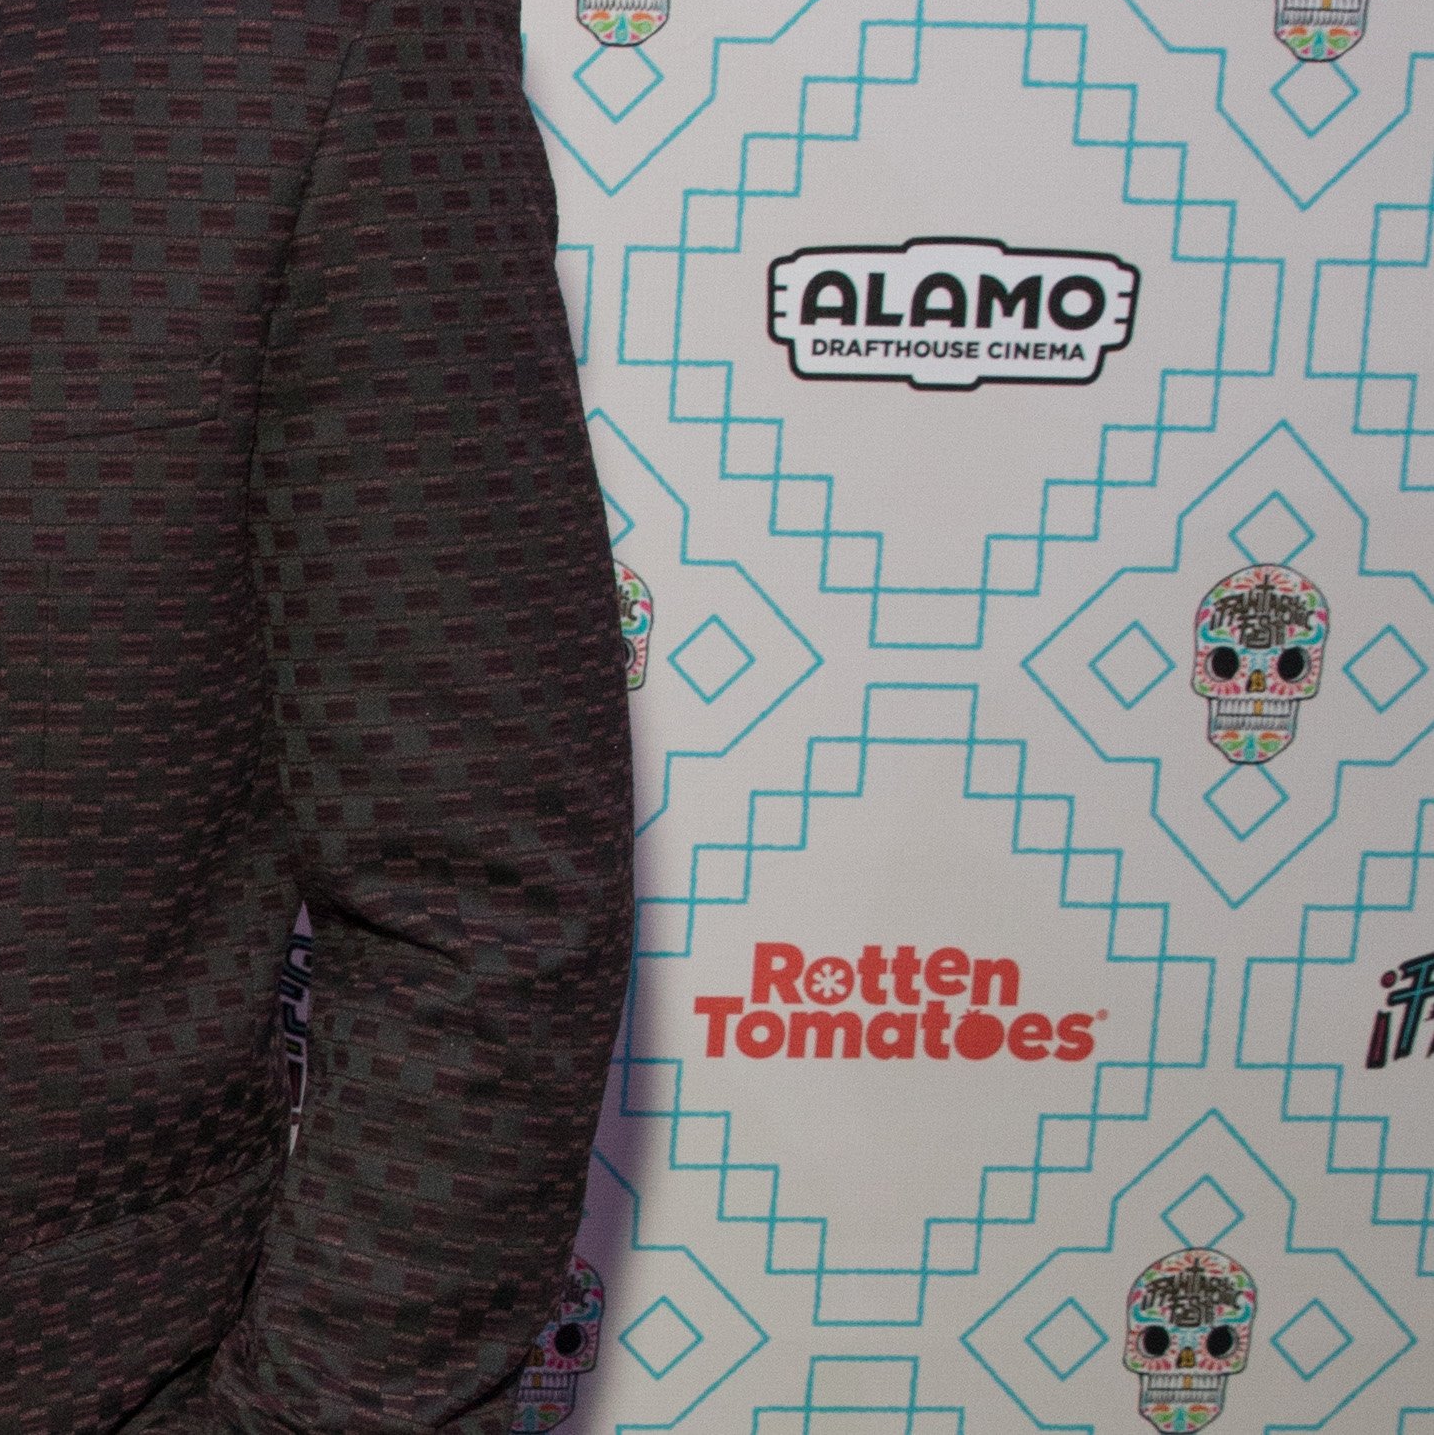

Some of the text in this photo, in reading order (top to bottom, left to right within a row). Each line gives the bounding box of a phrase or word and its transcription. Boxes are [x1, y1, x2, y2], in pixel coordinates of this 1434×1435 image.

[800, 270, 1106, 330] ALAMO
[811, 339, 1086, 361] DRAFTHOUSE CINEMA
[751, 942, 1020, 1006] Rotten
[694, 996, 1096, 1062] Tomatoes
